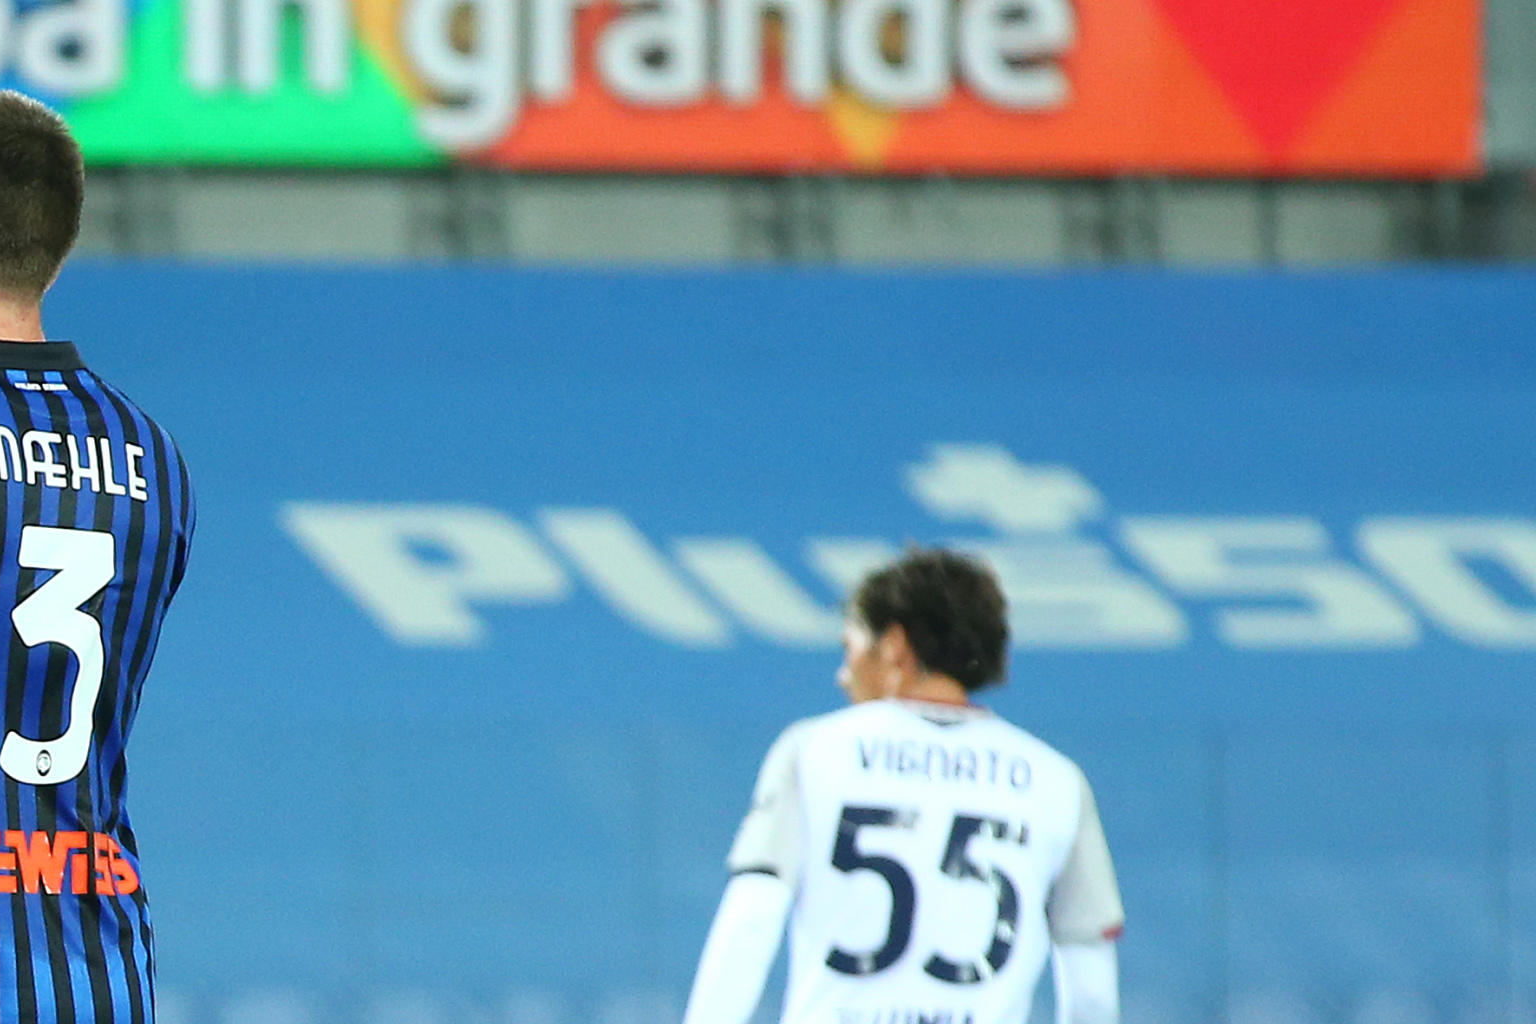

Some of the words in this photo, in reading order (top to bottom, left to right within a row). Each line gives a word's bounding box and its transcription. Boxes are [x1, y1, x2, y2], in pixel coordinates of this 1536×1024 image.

[180, 0, 348, 96] in
[398, 0, 1076, 152] grande
[0, 525, 117, 785] 3
[824, 805, 1031, 986] 55
